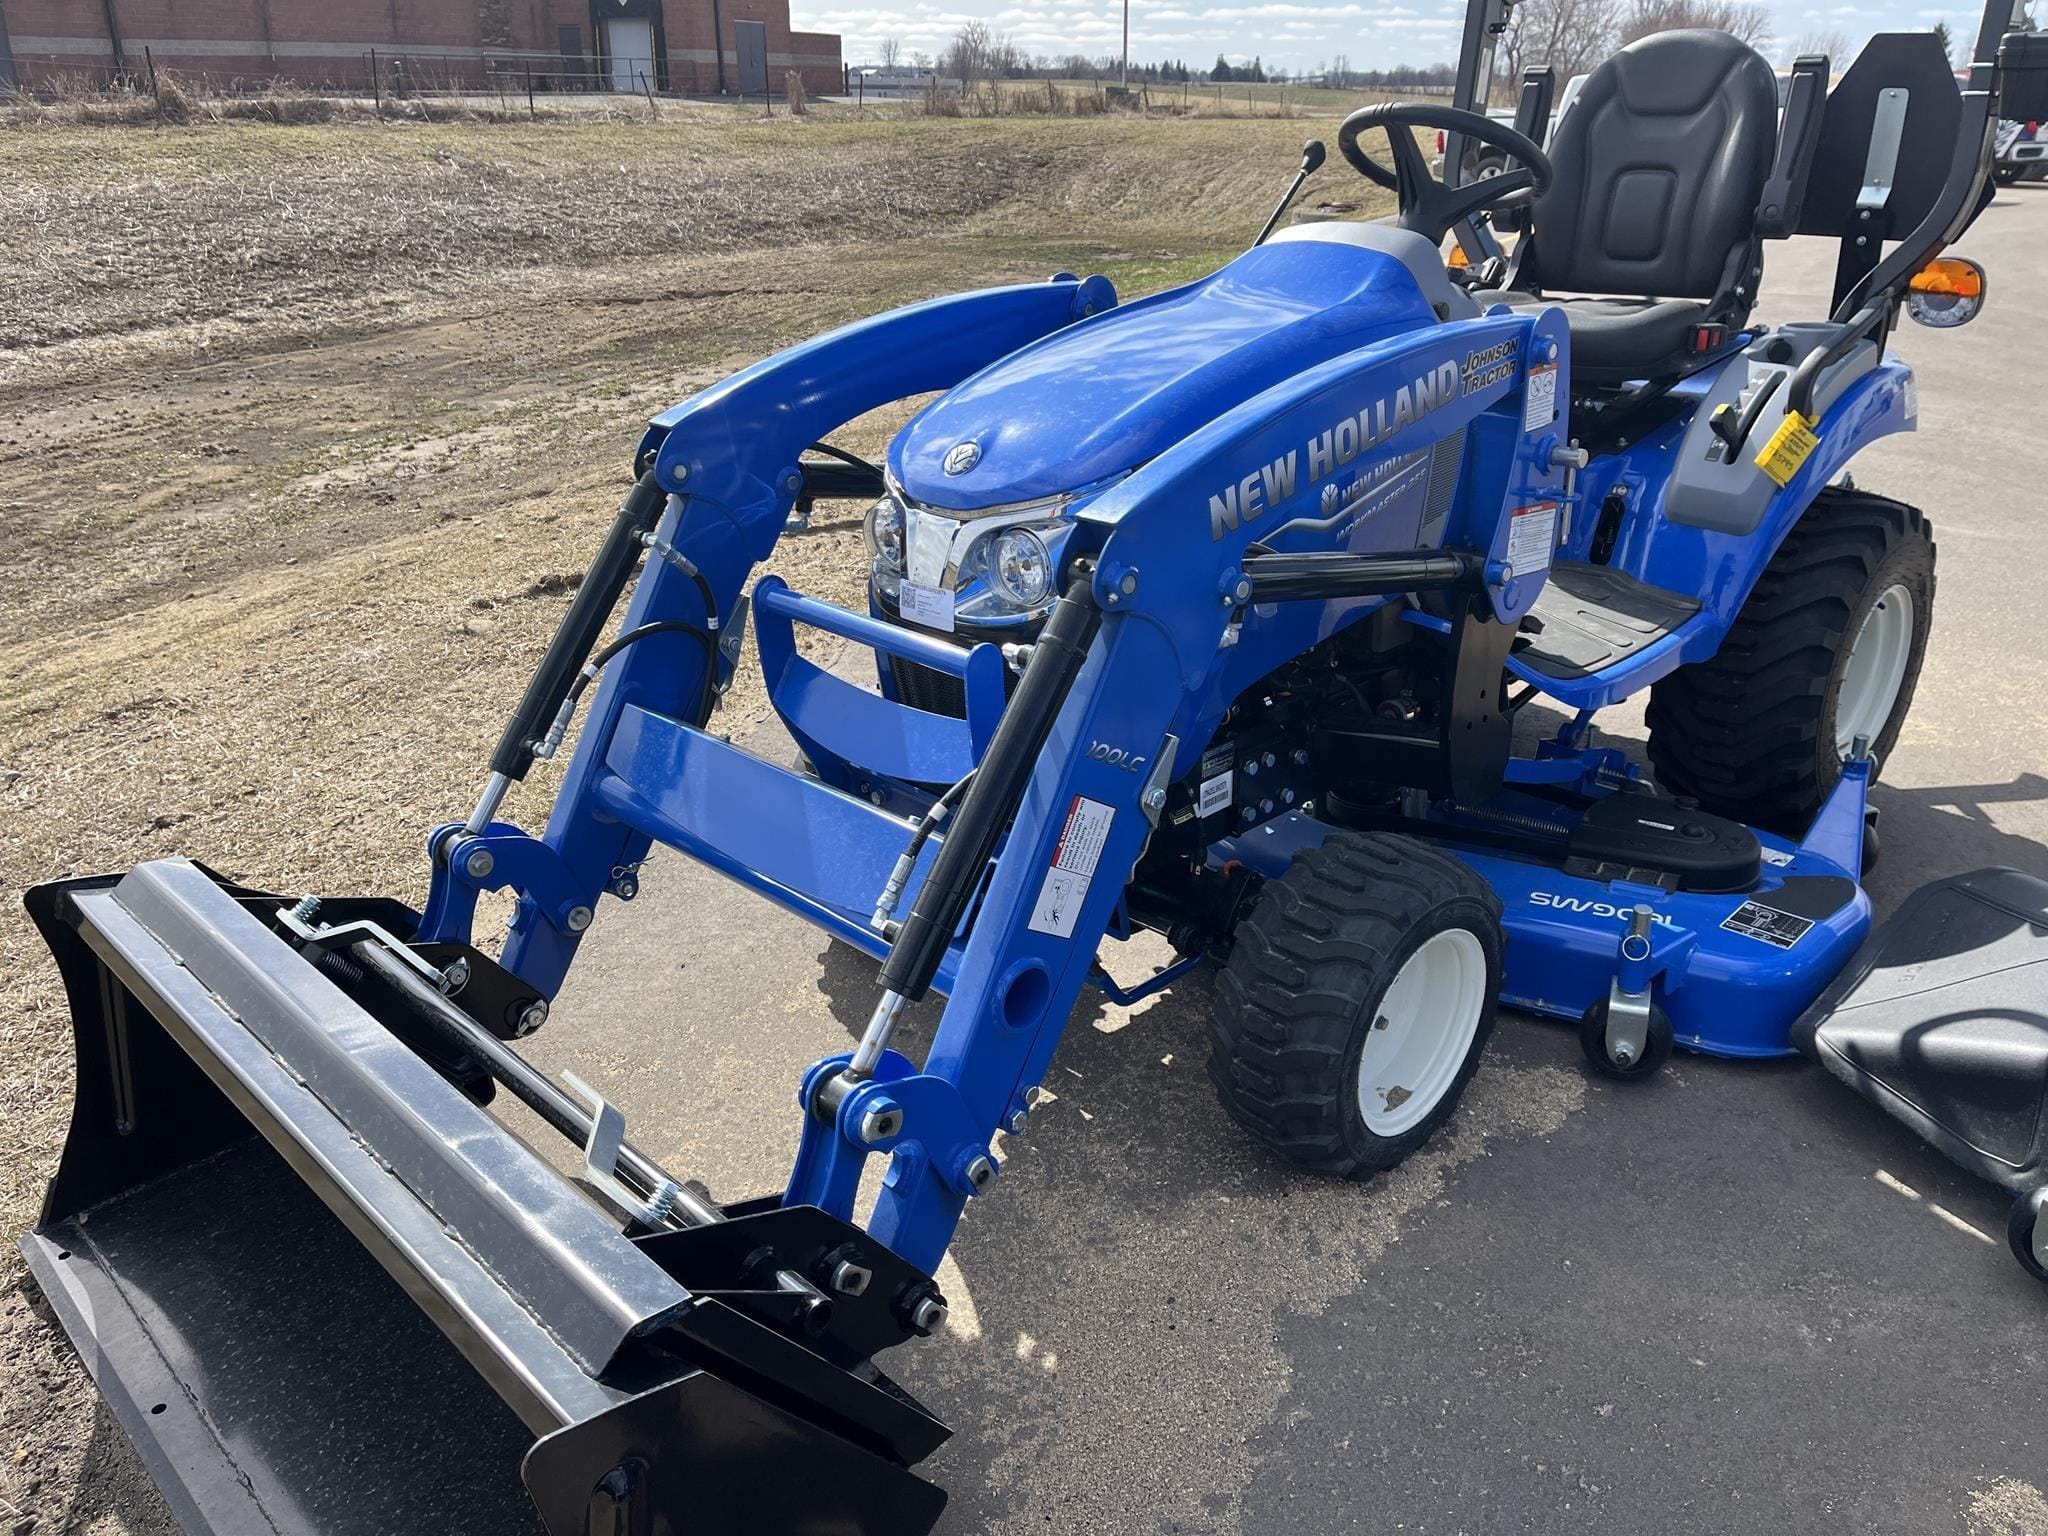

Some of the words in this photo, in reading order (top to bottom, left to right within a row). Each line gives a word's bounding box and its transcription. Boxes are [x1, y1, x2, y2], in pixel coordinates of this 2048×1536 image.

[1461, 336, 1519, 376] JOHNSON
[1462, 360, 1517, 397] TRACTOR
[1209, 448, 1297, 543] NEW
[1307, 359, 1459, 484] HOLLAND
[1342, 471, 1372, 505] NEW
[1087, 740, 1146, 774] 100LC
[1061, 814, 1073, 840] DANGER
